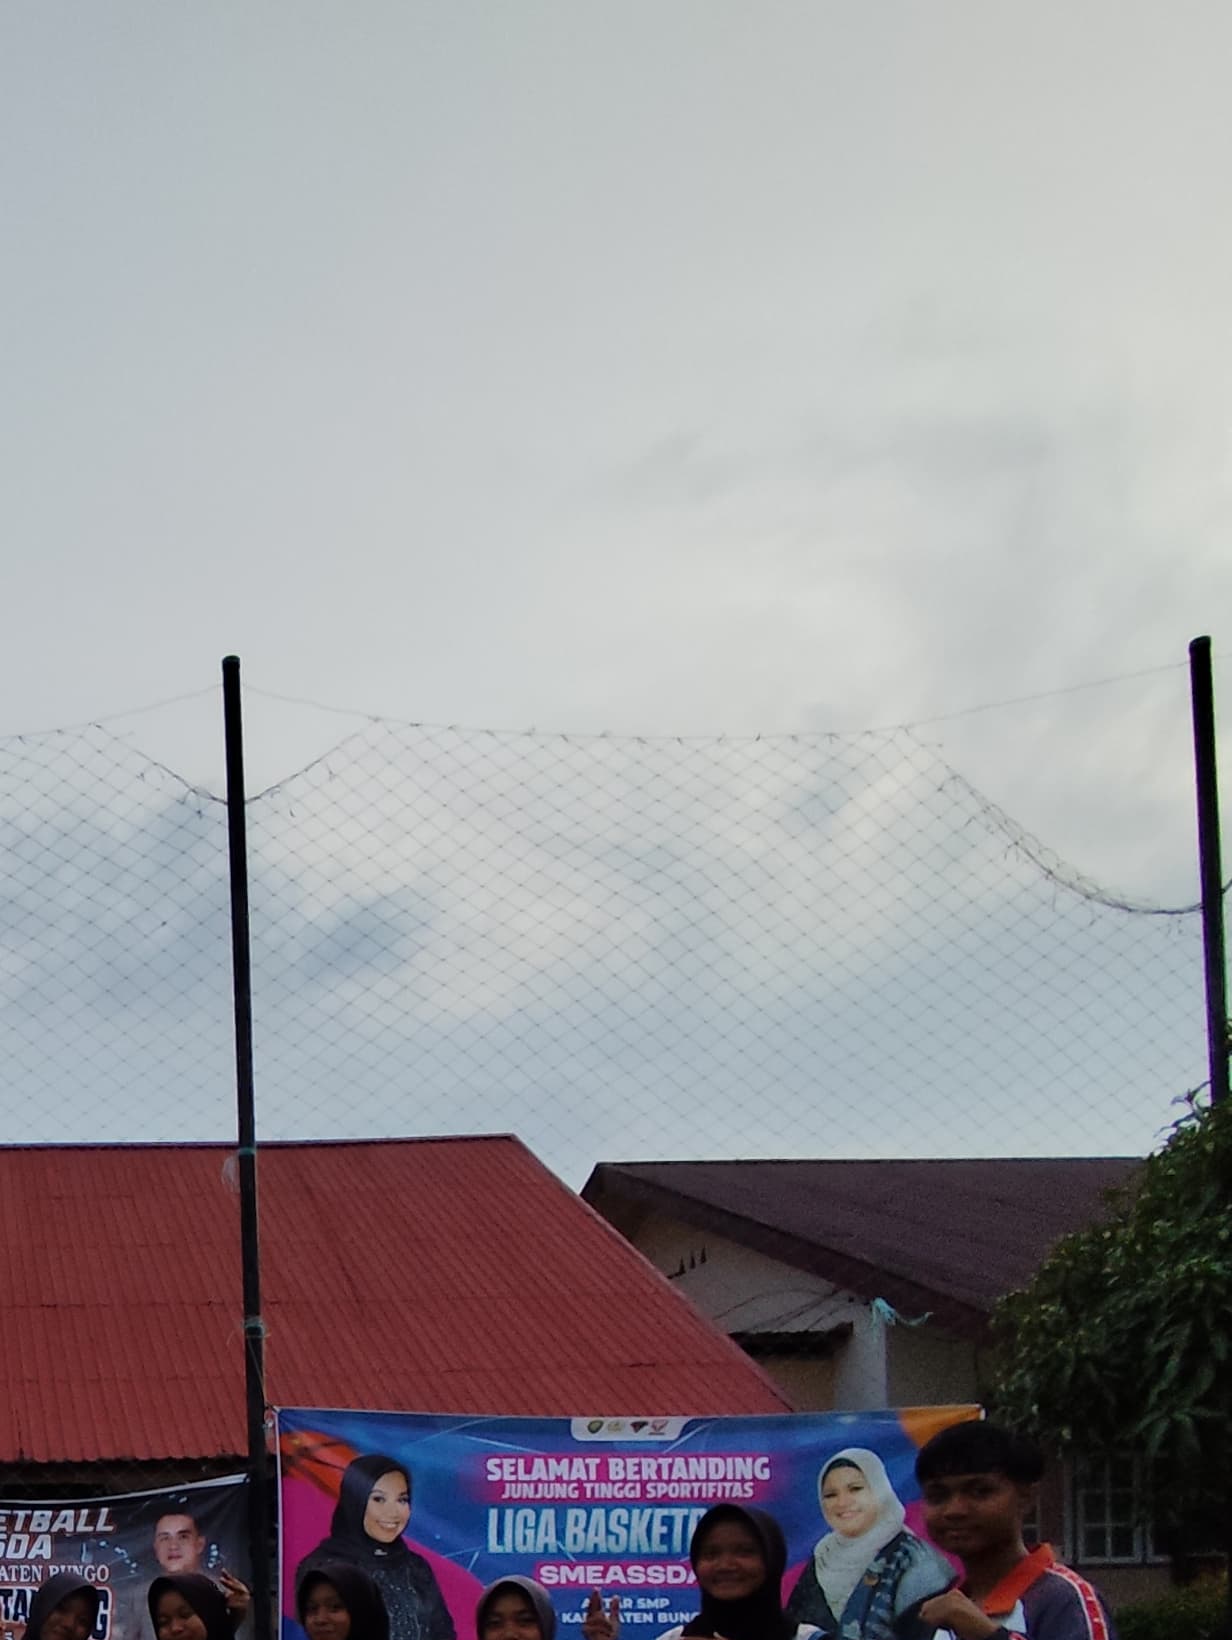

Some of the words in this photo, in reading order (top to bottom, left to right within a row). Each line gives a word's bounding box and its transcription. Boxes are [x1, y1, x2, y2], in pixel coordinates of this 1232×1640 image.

[487, 1458, 600, 1481] SELAMAT
[609, 1457, 770, 1481] BERTANDING
[502, 1482, 579, 1499] JUNJUNG
[584, 1482, 641, 1498] TINGGI
[646, 1481, 754, 1498] SPORTIFITAS
[488, 1508, 559, 1553] LIGA
[637, 1598, 670, 1609] SMP
